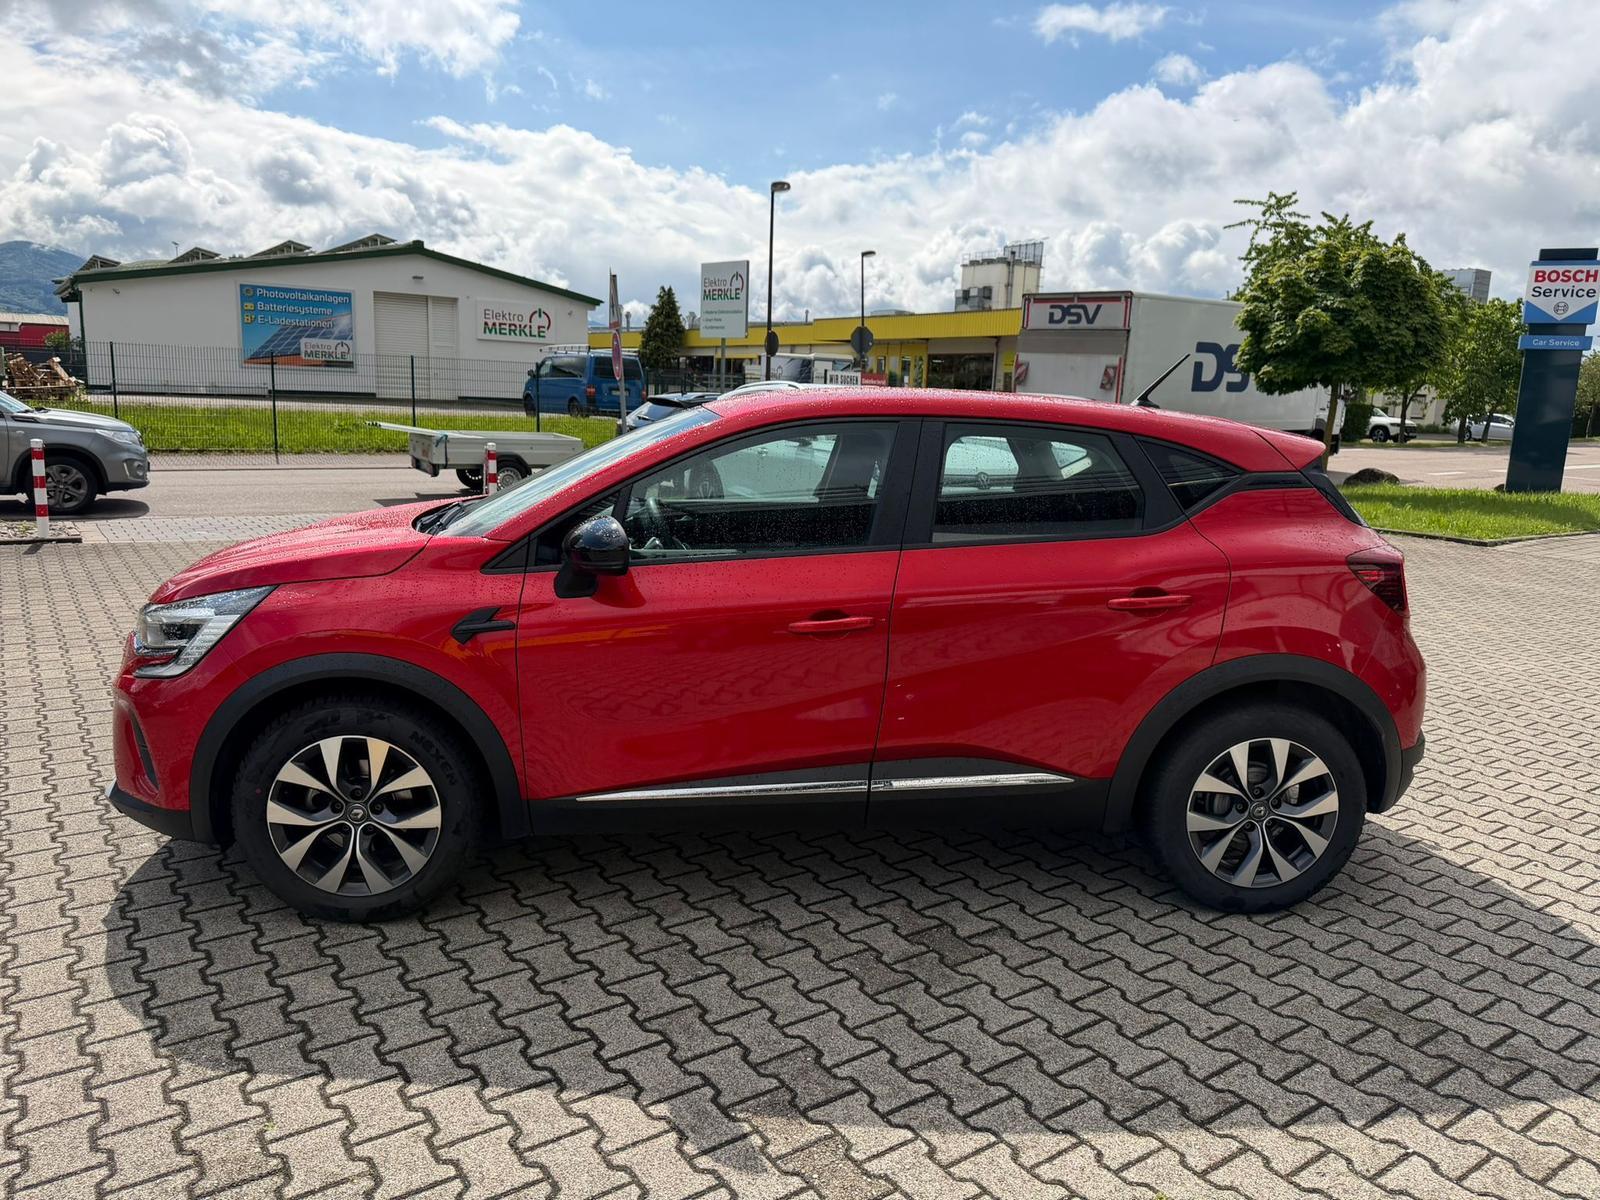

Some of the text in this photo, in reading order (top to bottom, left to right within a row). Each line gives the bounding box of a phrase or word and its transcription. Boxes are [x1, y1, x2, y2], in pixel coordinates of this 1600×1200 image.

[703, 277, 728, 288] Elektro
[1534, 269, 1599, 283] BOSCH
[256, 289, 349, 303] Photovoltaikanlagen
[702, 287, 741, 301] MERKLE
[1531, 285, 1597, 298] Service
[257, 303, 333, 315] Batteriesysteme
[483, 308, 525, 322] Elektro
[1048, 304, 1103, 325] DSV
[258, 315, 333, 328] E-Ladestationen
[483, 321, 547, 339] MERKLE
[304, 341, 332, 350] Elektro
[304, 350, 347, 360] MERKLE
[1190, 341, 1251, 393] DS
[829, 374, 839, 384] WIR
